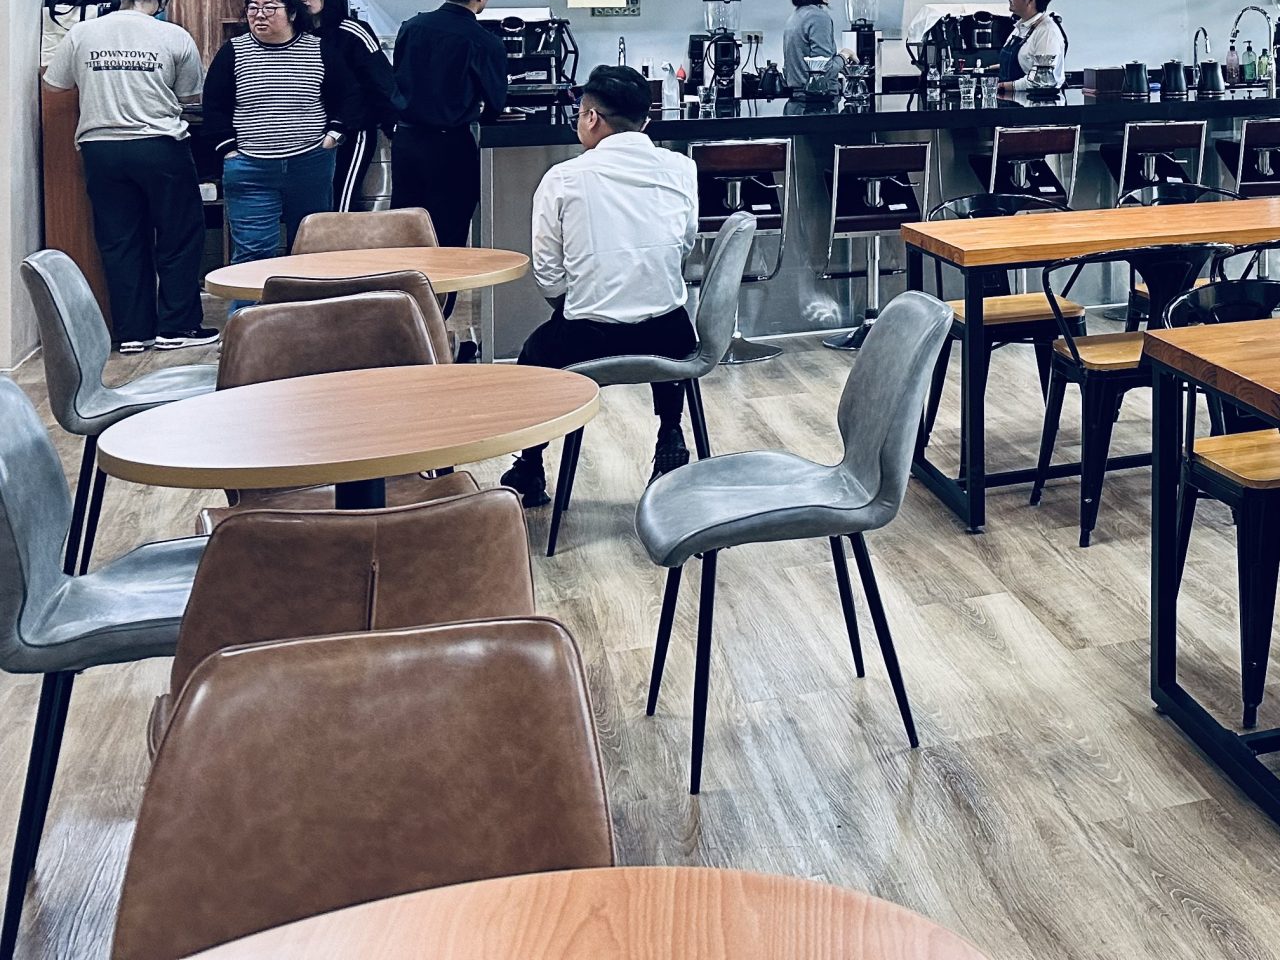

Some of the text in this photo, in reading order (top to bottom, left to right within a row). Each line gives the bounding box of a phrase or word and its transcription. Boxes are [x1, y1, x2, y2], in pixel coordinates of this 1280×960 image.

[90, 50, 159, 61] DOWNTOWN
[85, 60, 101, 68] THE
[103, 60, 164, 69] ROADMASTER
